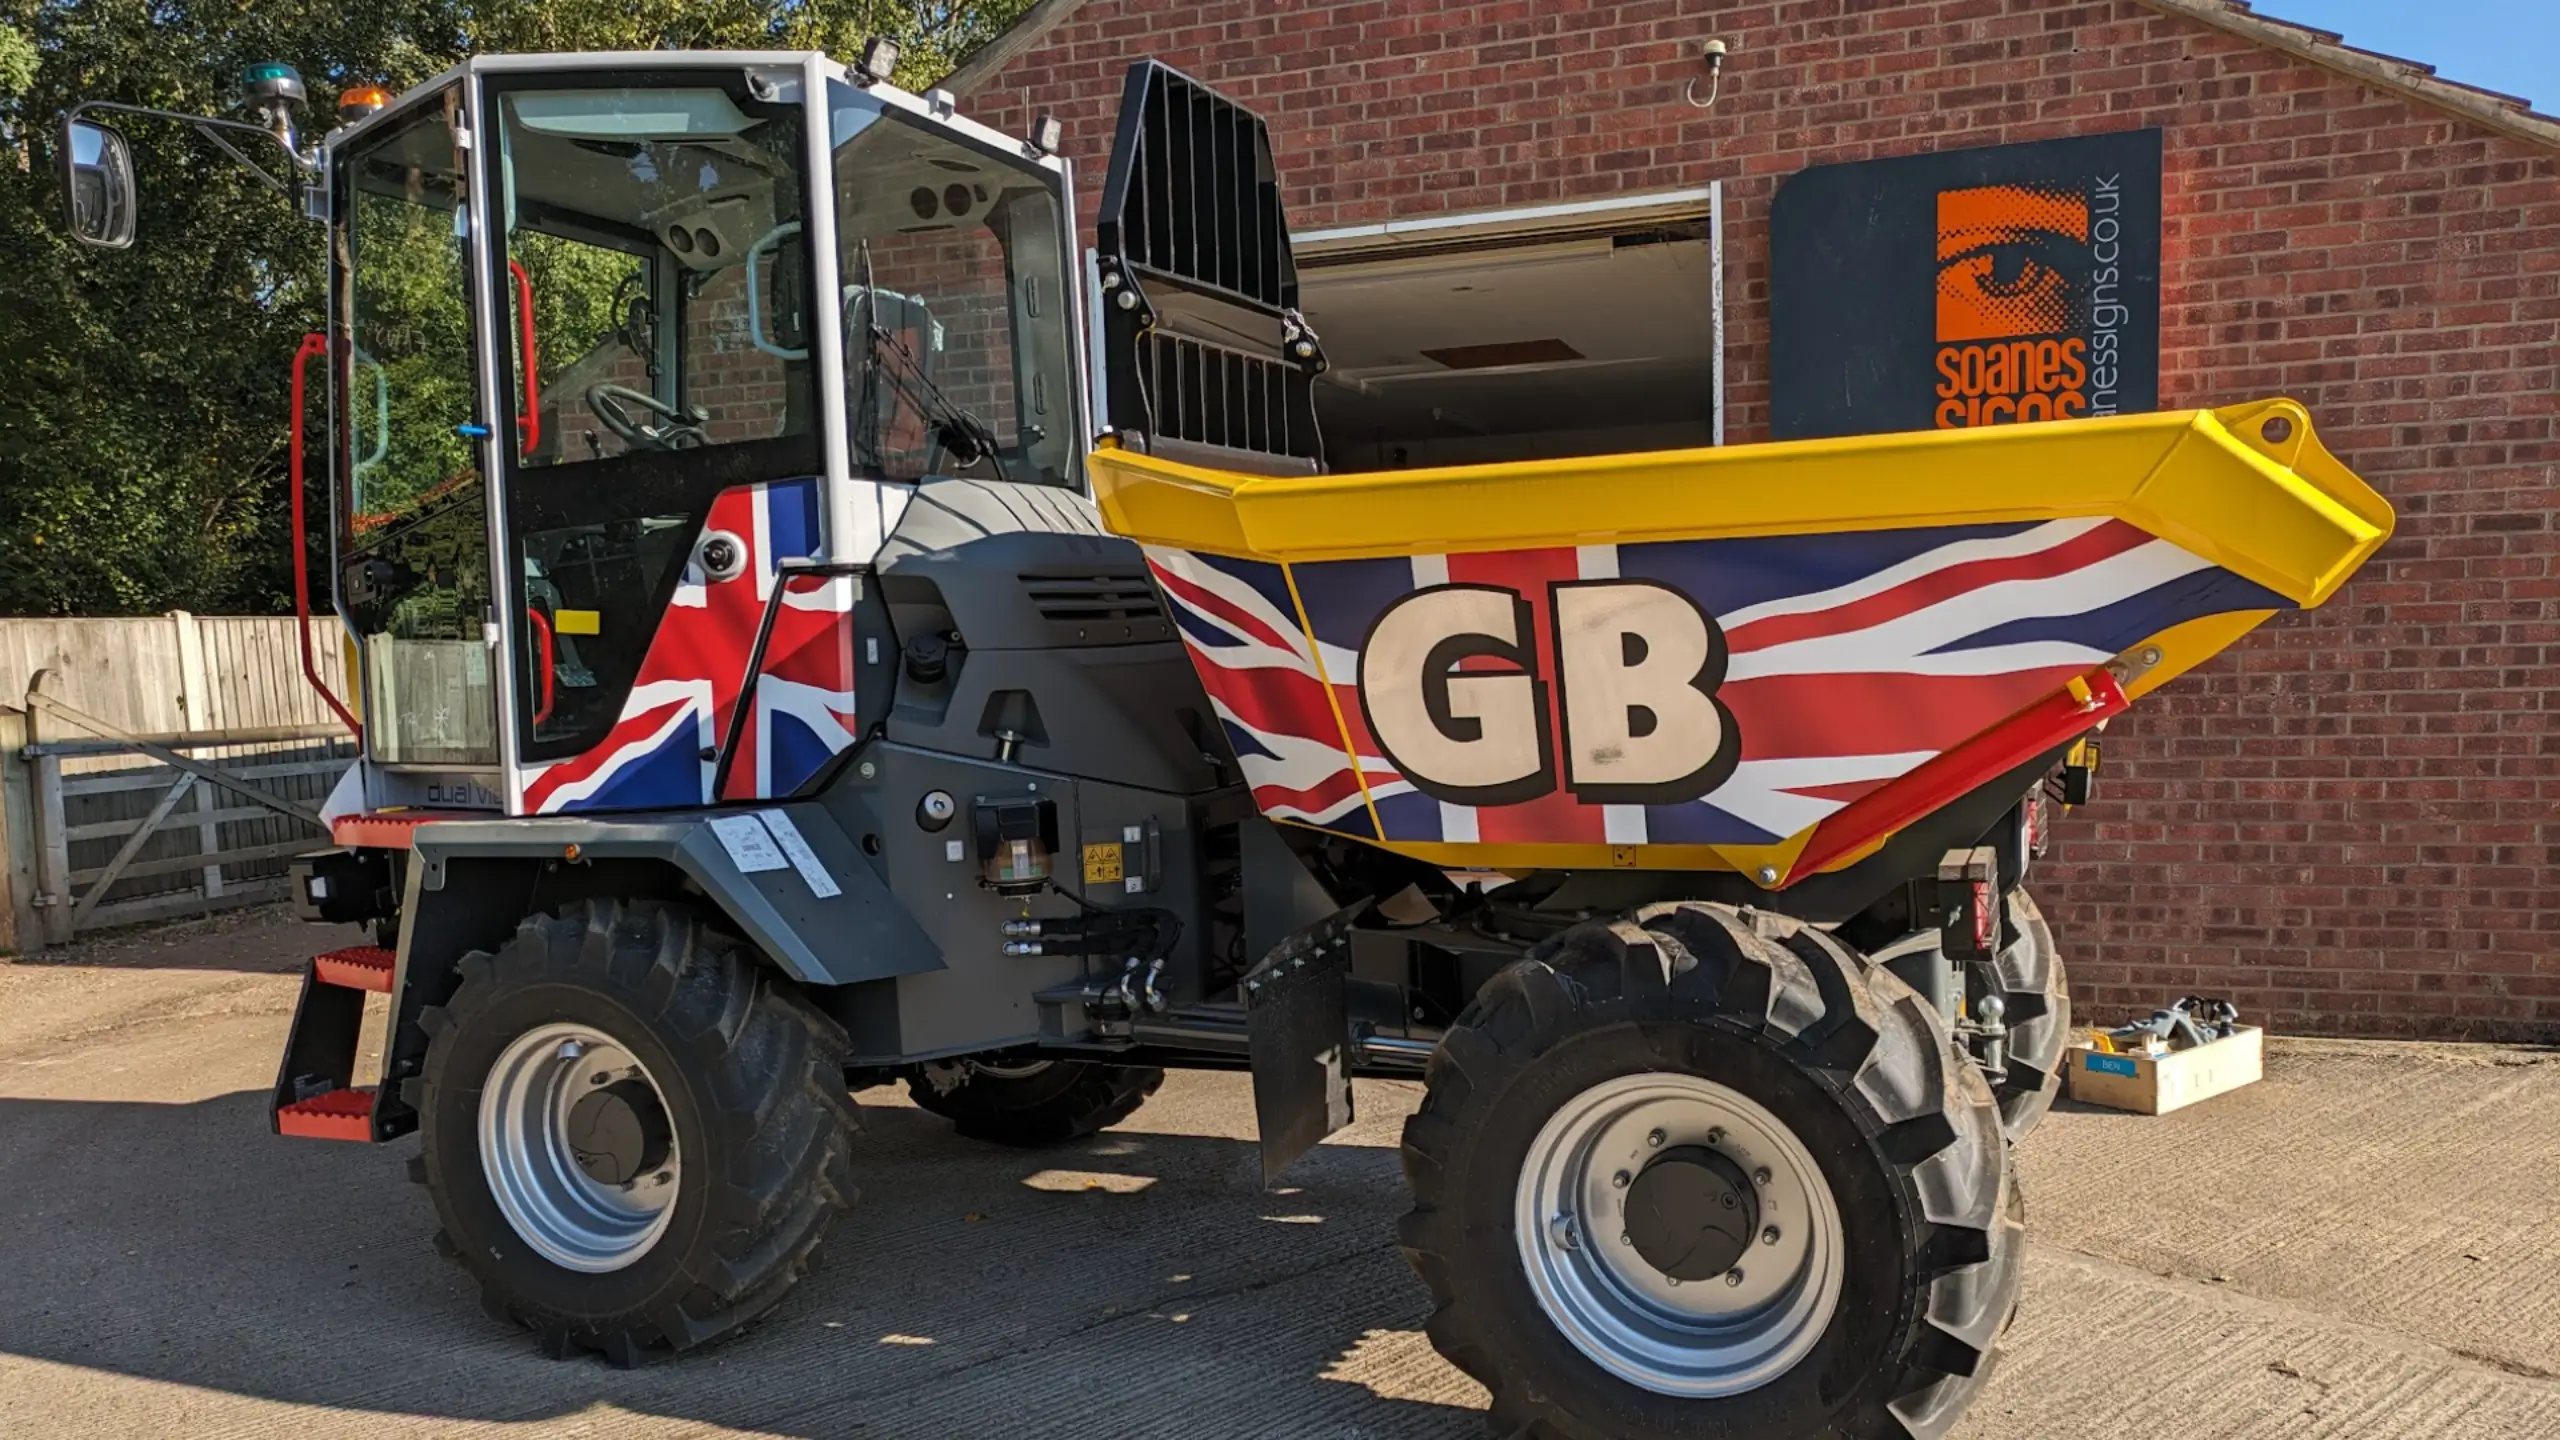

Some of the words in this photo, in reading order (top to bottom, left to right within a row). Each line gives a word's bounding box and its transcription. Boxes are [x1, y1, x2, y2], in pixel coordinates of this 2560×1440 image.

[1936, 337, 2086, 398] soanes
[1357, 577, 1742, 806] GB
[427, 781, 472, 804] dual
